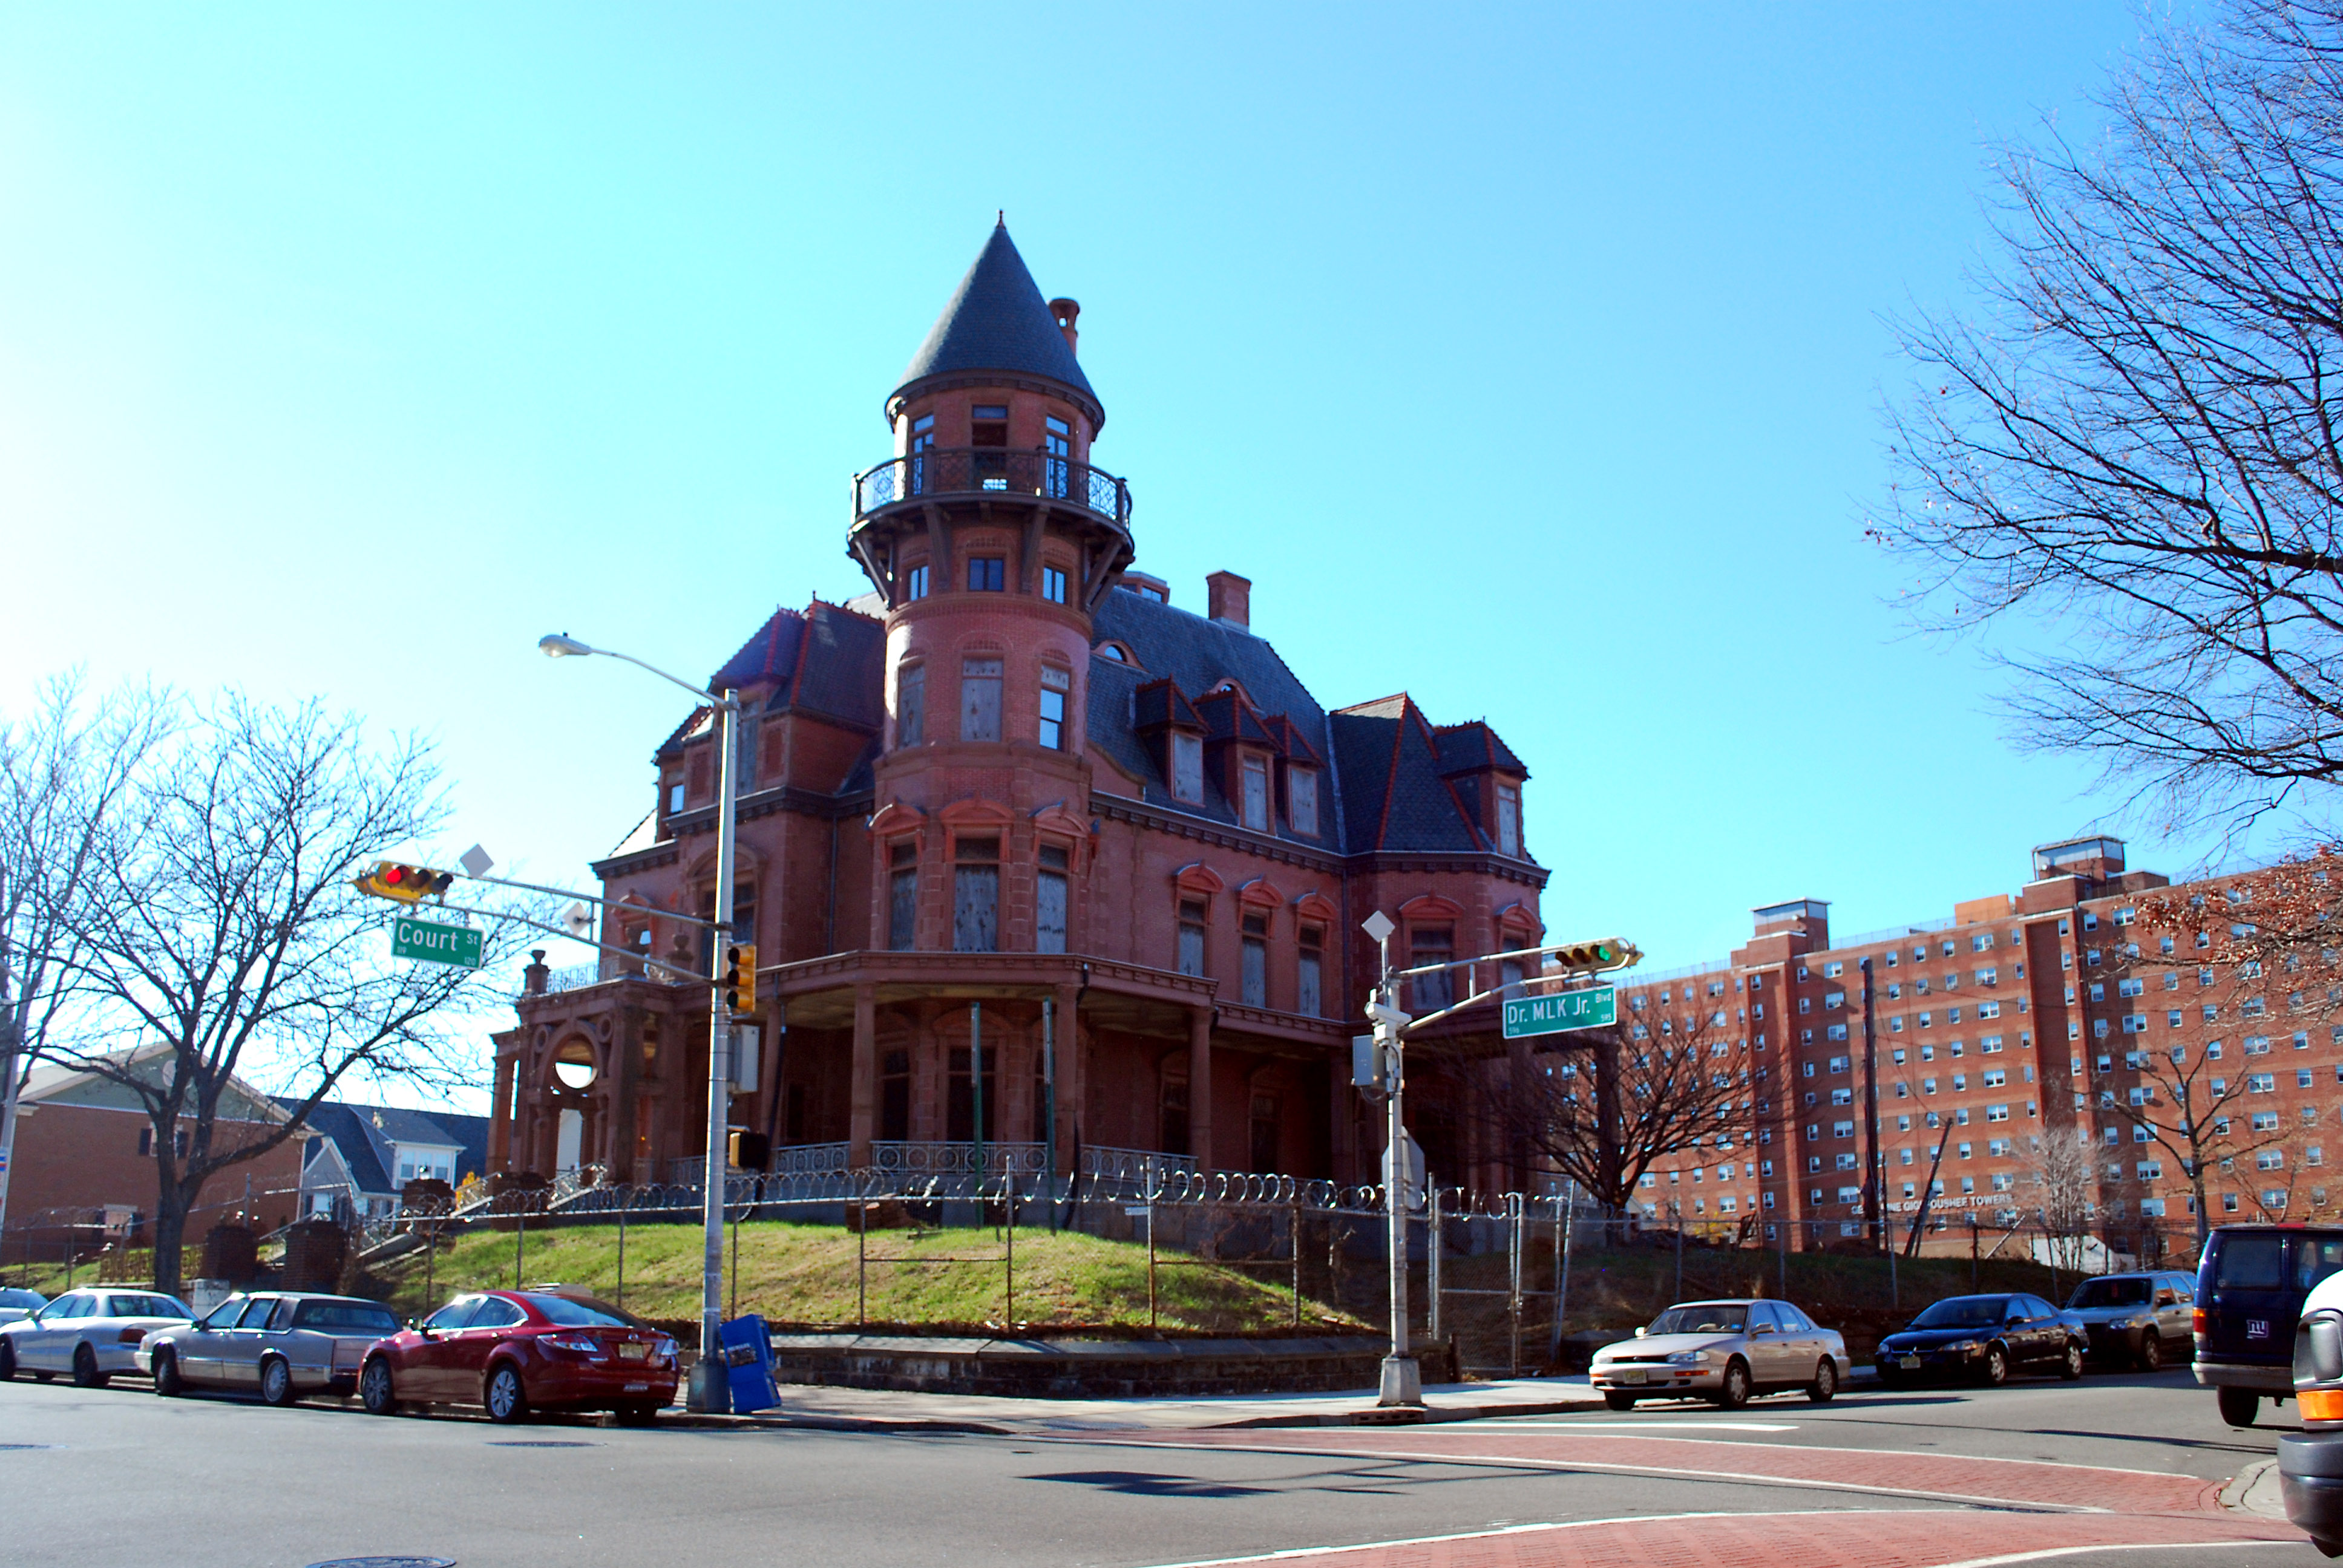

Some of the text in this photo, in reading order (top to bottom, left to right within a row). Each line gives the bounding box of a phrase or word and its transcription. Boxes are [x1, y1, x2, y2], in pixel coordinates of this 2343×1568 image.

[398, 922, 478, 951] Court St
[1508, 992, 1612, 1024] Dr. MLK Jr. Blvd
[1970, 1194, 2013, 1206] TOWERS
